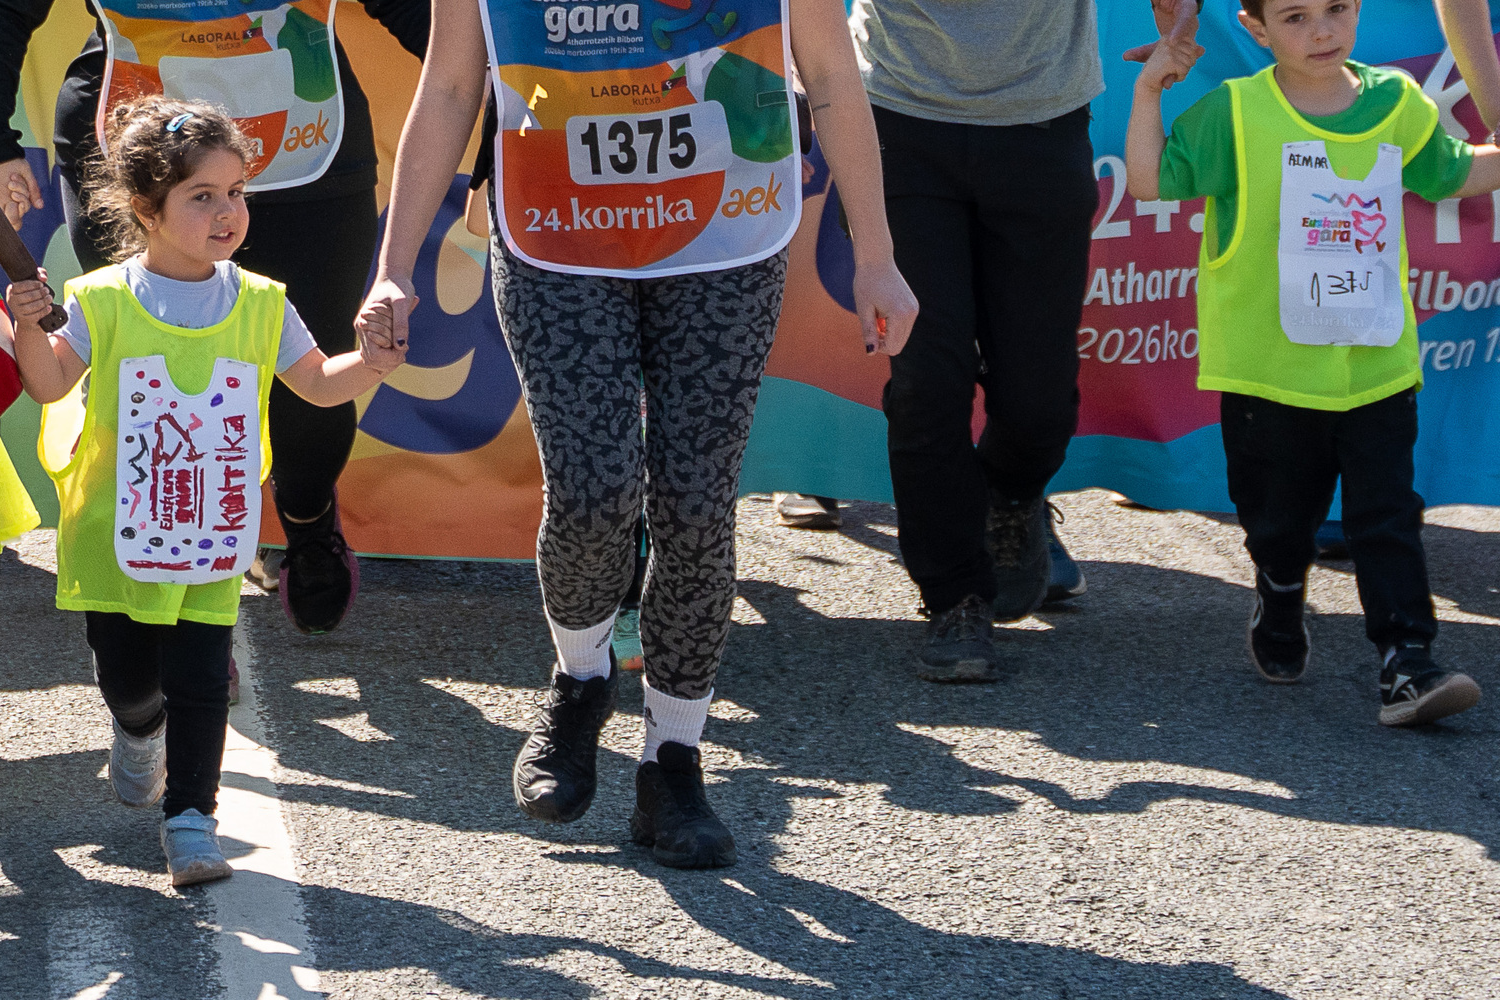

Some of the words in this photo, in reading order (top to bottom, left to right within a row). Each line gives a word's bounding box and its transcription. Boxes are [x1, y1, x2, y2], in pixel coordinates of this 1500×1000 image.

[181, 31, 240, 44] LABORAL
[544, 2, 640, 42] gara
[616, 35, 644, 43] Bilbora
[591, 83, 659, 98] LABORAL
[632, 95, 661, 107] kutxa
[283, 109, 330, 152] aek
[580, 112, 697, 176] 1375
[1288, 152, 1329, 170] AIMAR
[524, 194, 697, 232] 24.korrika
[721, 172, 783, 218] aek
[1306, 229, 1351, 246] gara
[1083, 262, 1199, 306] Atharr
[1077, 320, 1200, 365] 2026ko
